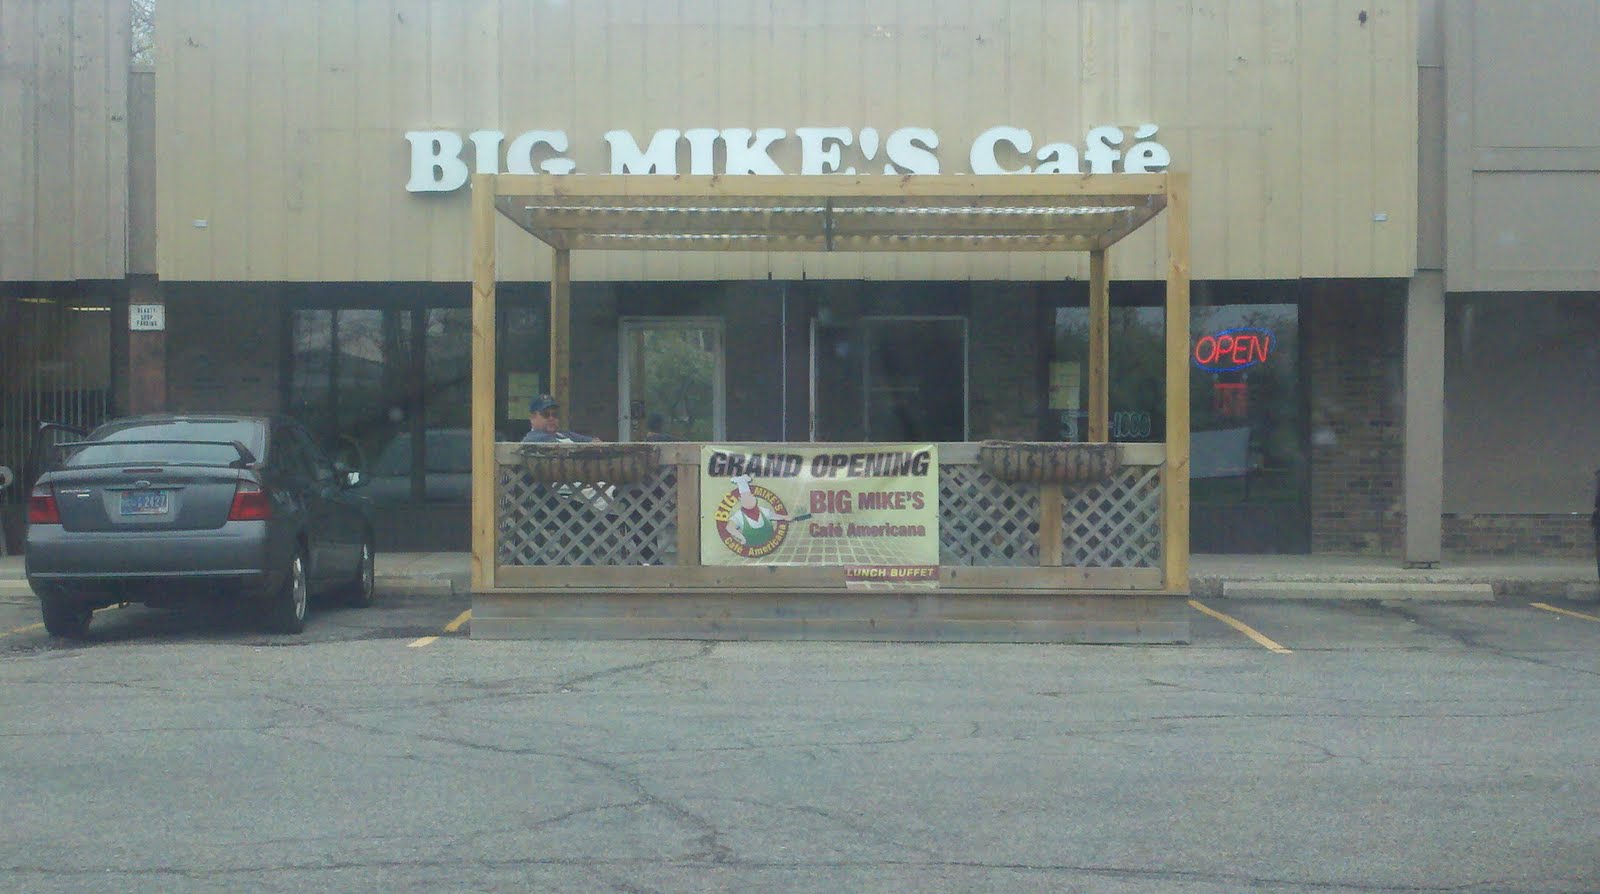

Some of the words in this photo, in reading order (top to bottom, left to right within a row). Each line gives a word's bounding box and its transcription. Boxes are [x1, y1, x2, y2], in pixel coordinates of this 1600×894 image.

[405, 129, 576, 193] BIG
[604, 127, 940, 175] MIKE'S
[969, 123, 1171, 175] Café
[1193, 335, 1270, 364] OPEN
[708, 452, 803, 478] GRAND
[810, 451, 931, 478] OPENING
[714, 492, 741, 522] BIG
[754, 487, 784, 512] MIKE'S
[809, 490, 852, 514] BIG
[858, 491, 925, 510] MIKE'S
[809, 523, 843, 537] Café
[847, 523, 926, 537] Americana
[847, 568, 886, 577] LUNCH
[890, 568, 934, 577] BUFFET
